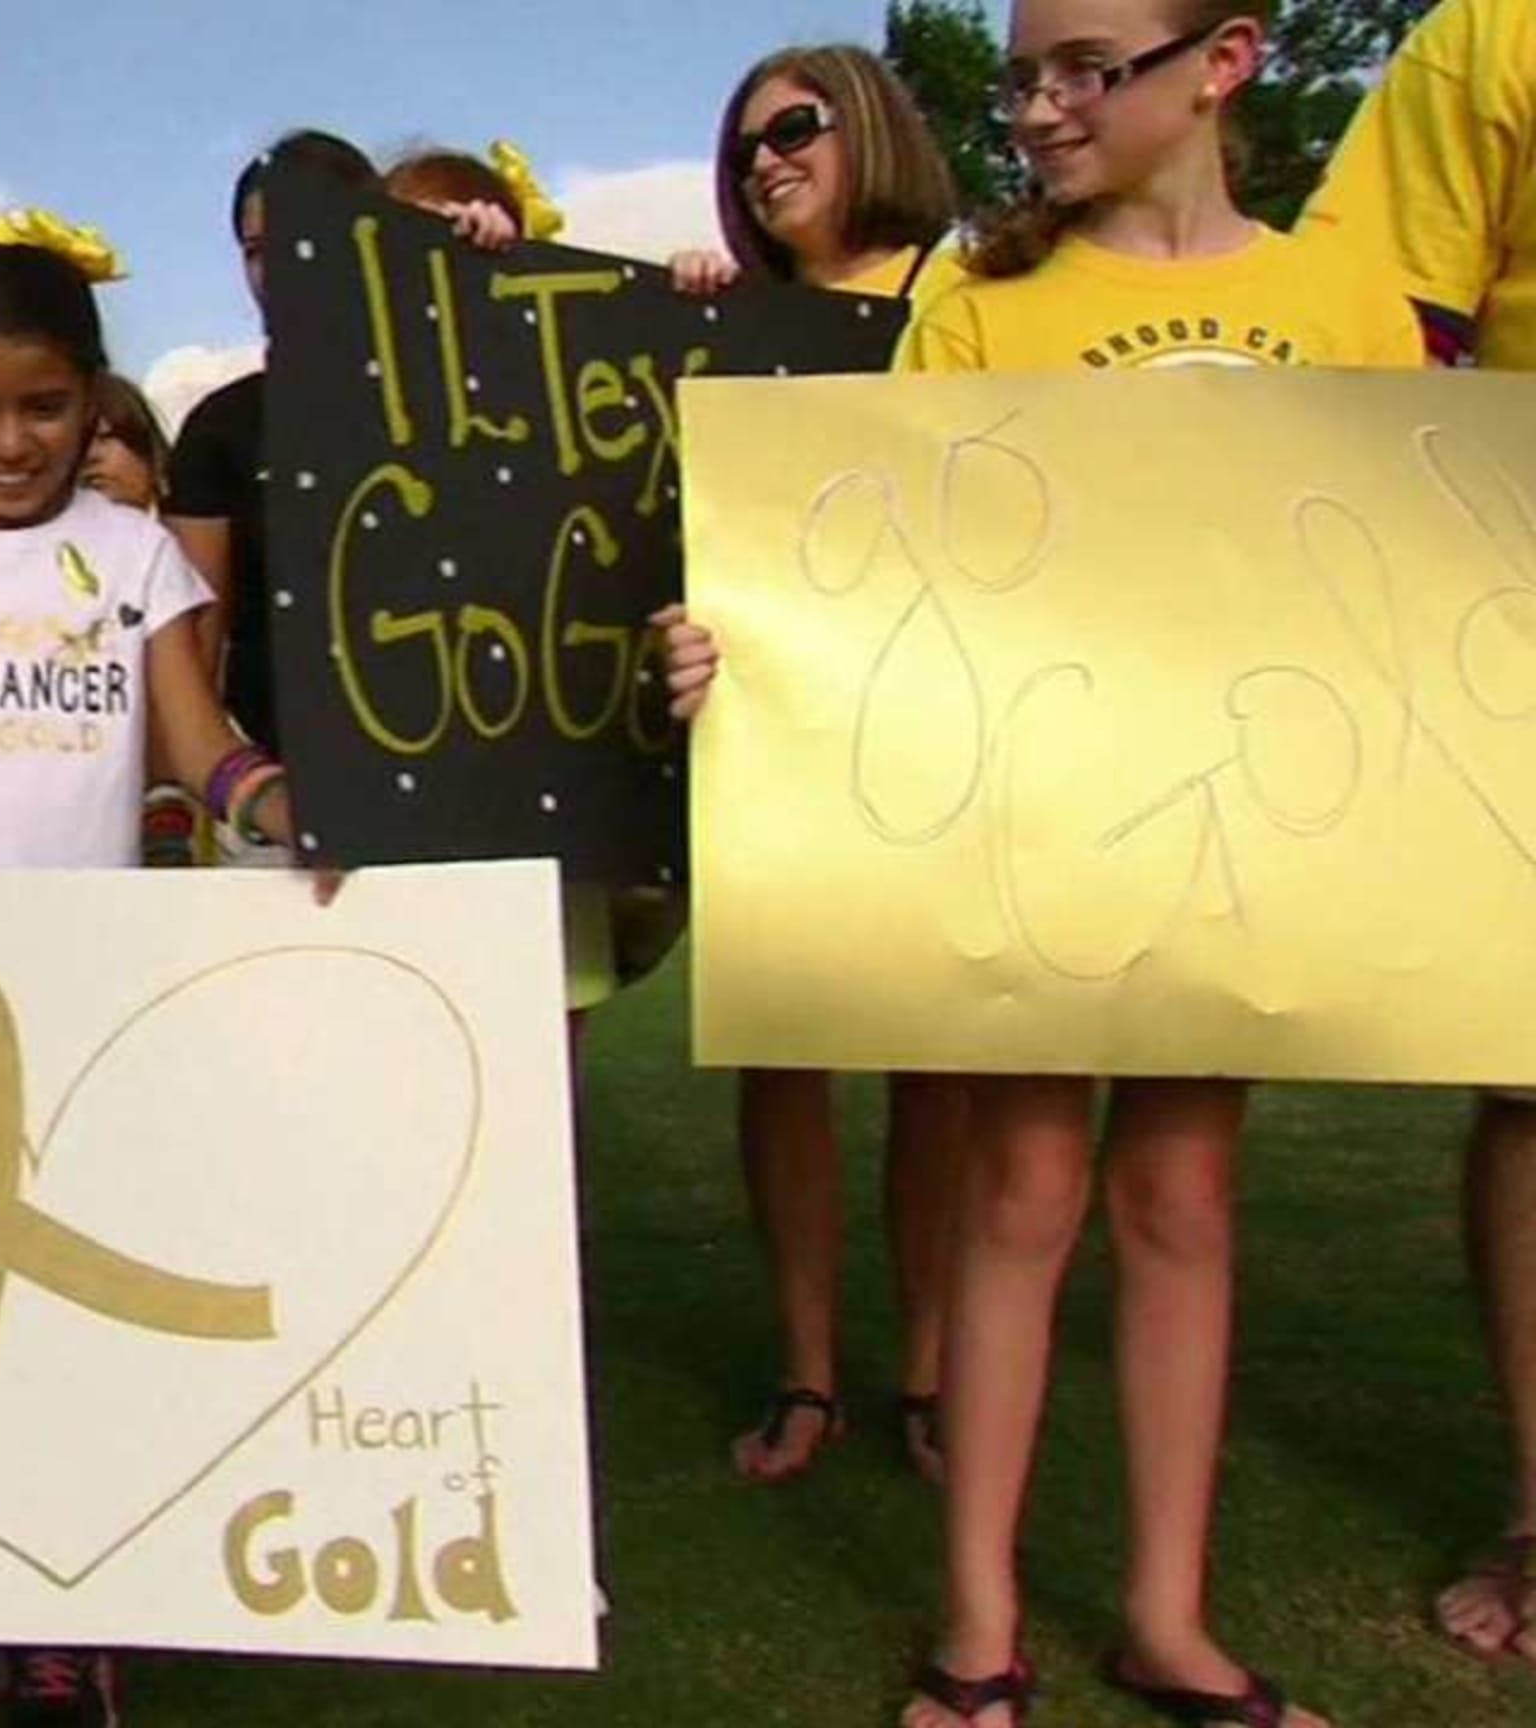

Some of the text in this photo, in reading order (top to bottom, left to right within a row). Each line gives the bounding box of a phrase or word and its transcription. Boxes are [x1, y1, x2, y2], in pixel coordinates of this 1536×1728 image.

[307, 1378, 504, 1453] Heart
[442, 1454, 504, 1496] of
[222, 1489, 519, 1624] Gold
